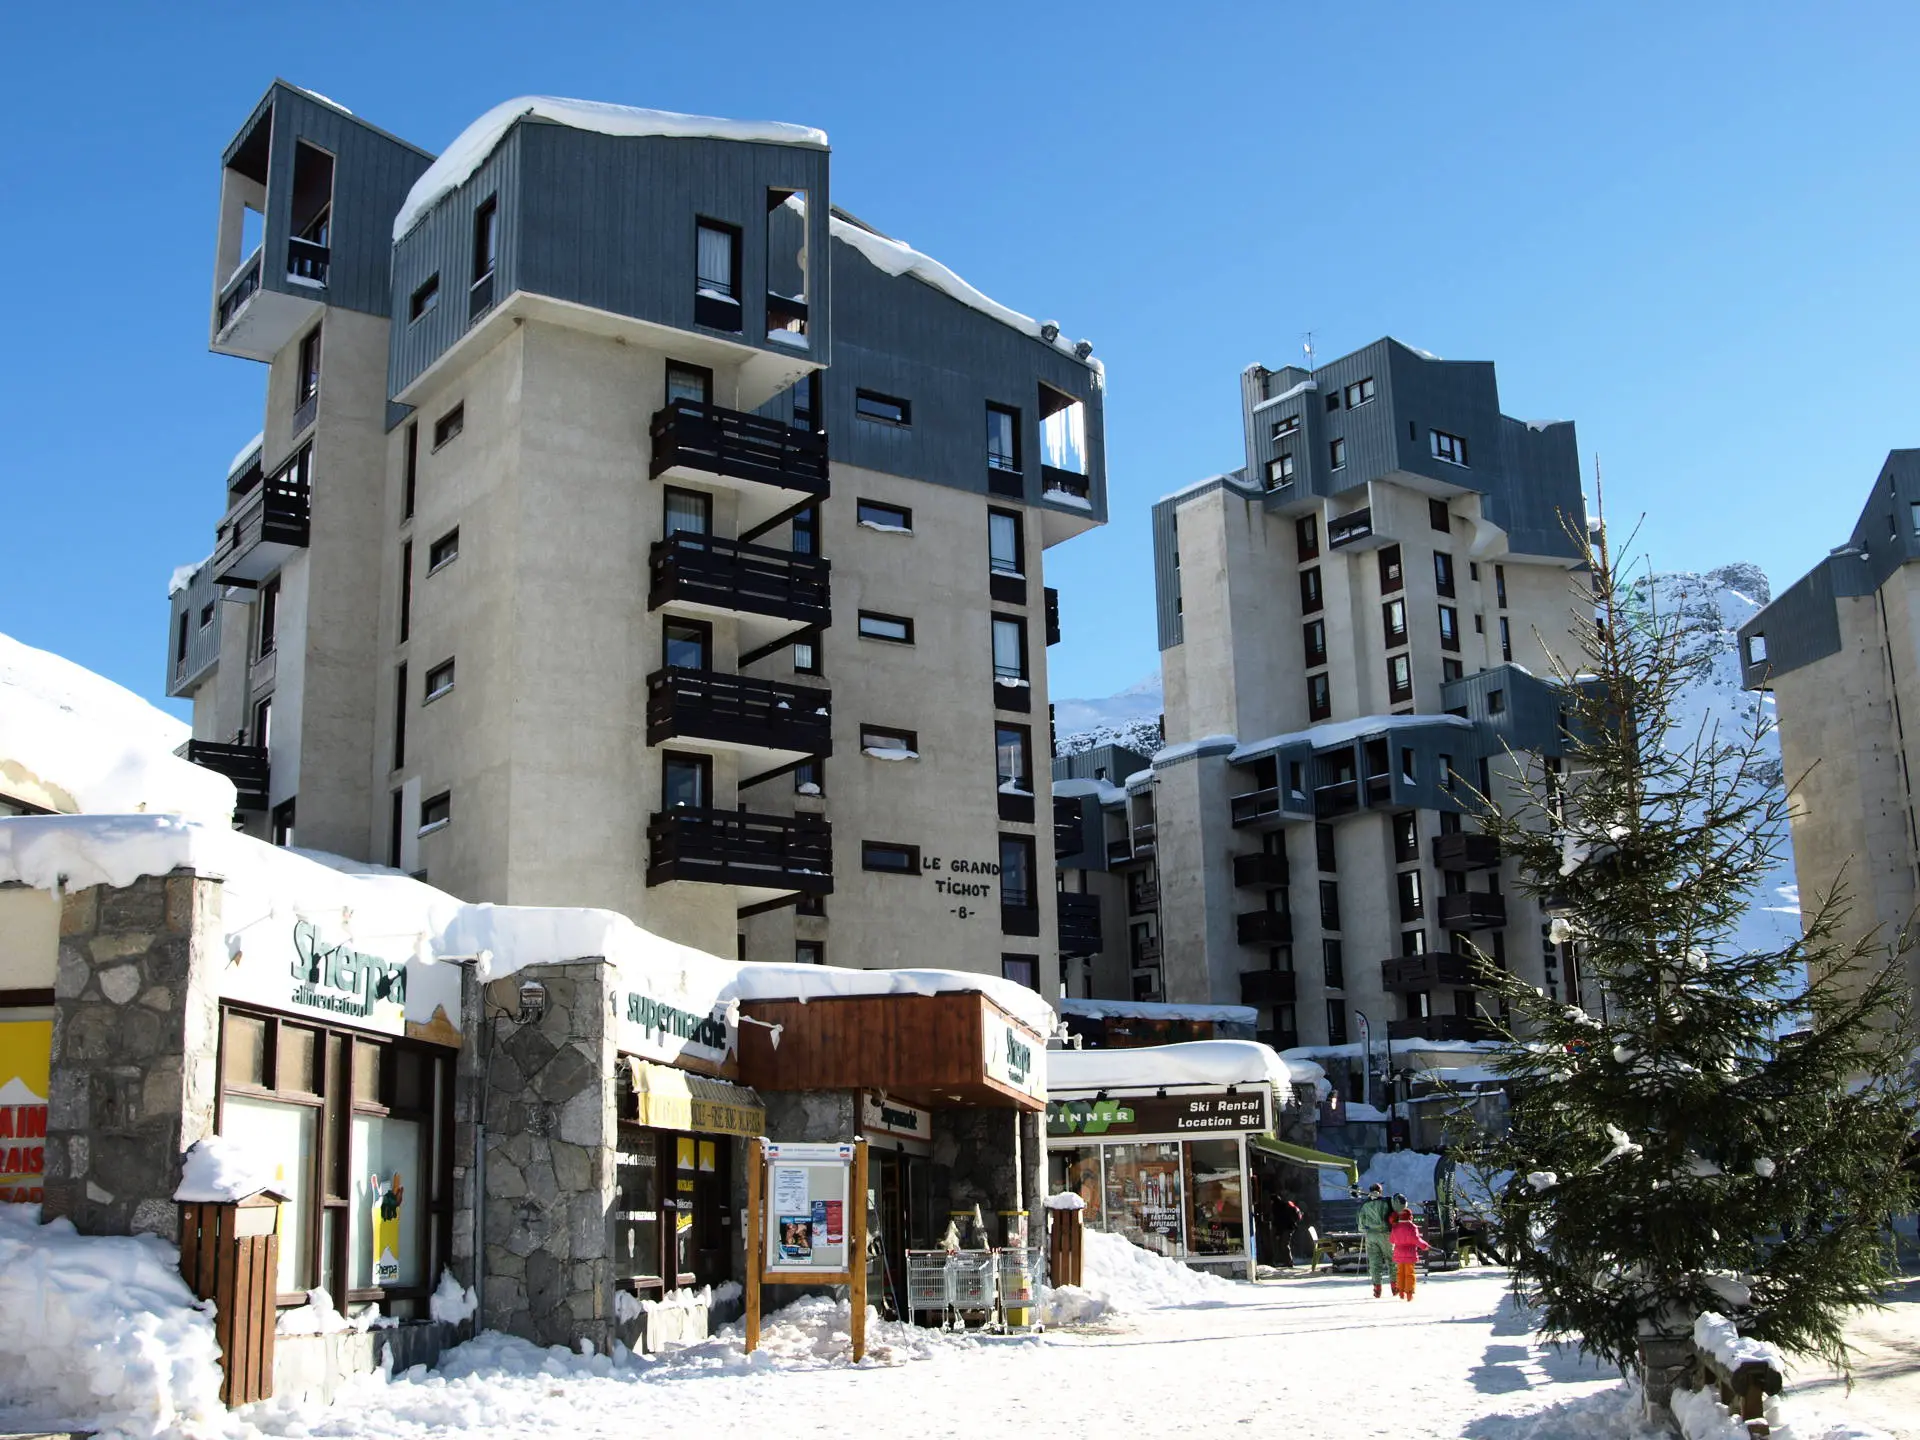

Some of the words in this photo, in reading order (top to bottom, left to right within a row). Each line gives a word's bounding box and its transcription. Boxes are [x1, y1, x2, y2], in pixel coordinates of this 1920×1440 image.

[923, 857, 941, 870] LE
[951, 859, 1000, 875] GRAND
[291, 920, 407, 1016] Sherpa
[291, 985, 367, 1018] alimentation
[1190, 1102, 1210, 1113] Ski
[1218, 1099, 1259, 1111] Rental
[1178, 1116, 1232, 1128] Location
[1240, 1115, 1260, 1125] Ski
